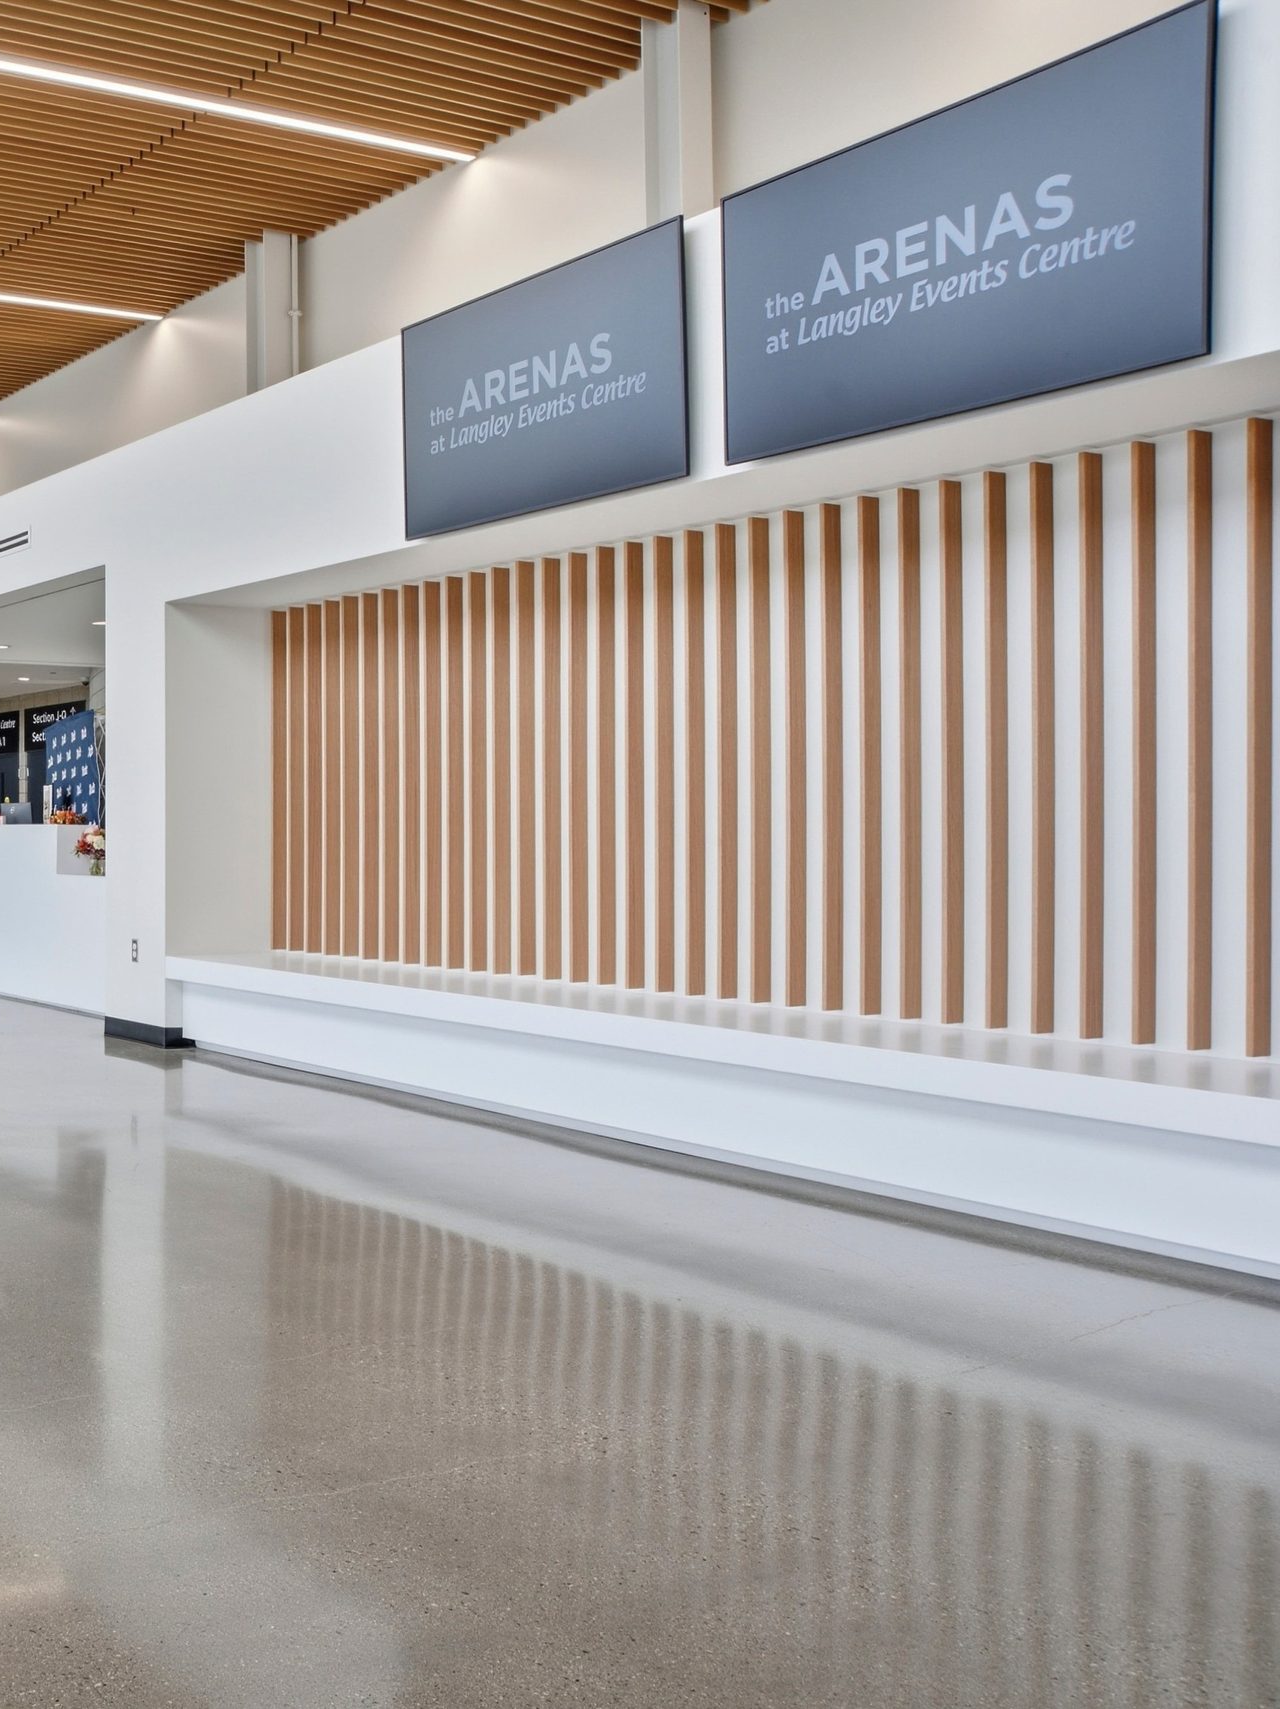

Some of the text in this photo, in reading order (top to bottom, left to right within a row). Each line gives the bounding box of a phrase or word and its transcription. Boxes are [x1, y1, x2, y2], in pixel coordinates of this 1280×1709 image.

[765, 173, 1075, 319] the ARENAS
[766, 219, 1137, 354] at Langley Events Centre
[429, 332, 613, 427] the ARENAS
[430, 371, 647, 455] at Langley Events Centre
[31, 731, 46, 743] Sect
[32, 711, 55, 724] Section
